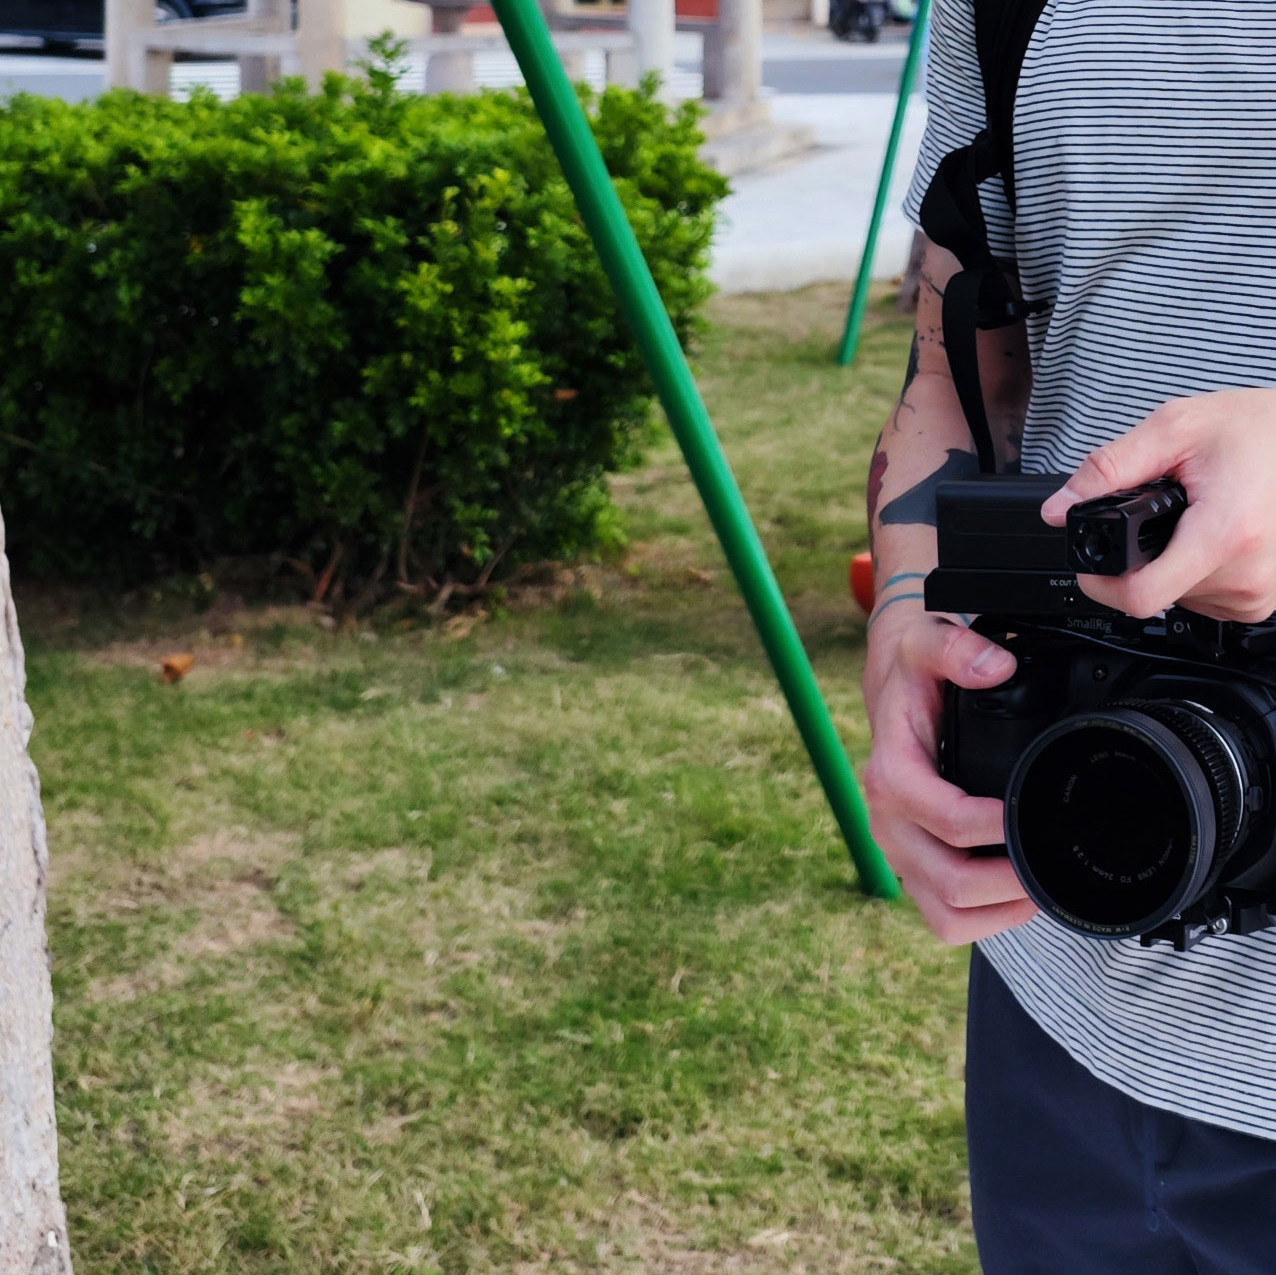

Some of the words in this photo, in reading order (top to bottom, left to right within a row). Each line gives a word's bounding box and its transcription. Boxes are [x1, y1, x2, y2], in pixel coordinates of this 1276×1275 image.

[1059, 579, 1072, 587] OUT
[1066, 616, 1112, 634] SmallRig
[1063, 774, 1078, 803] CANON
[1120, 875, 1132, 883] FD
